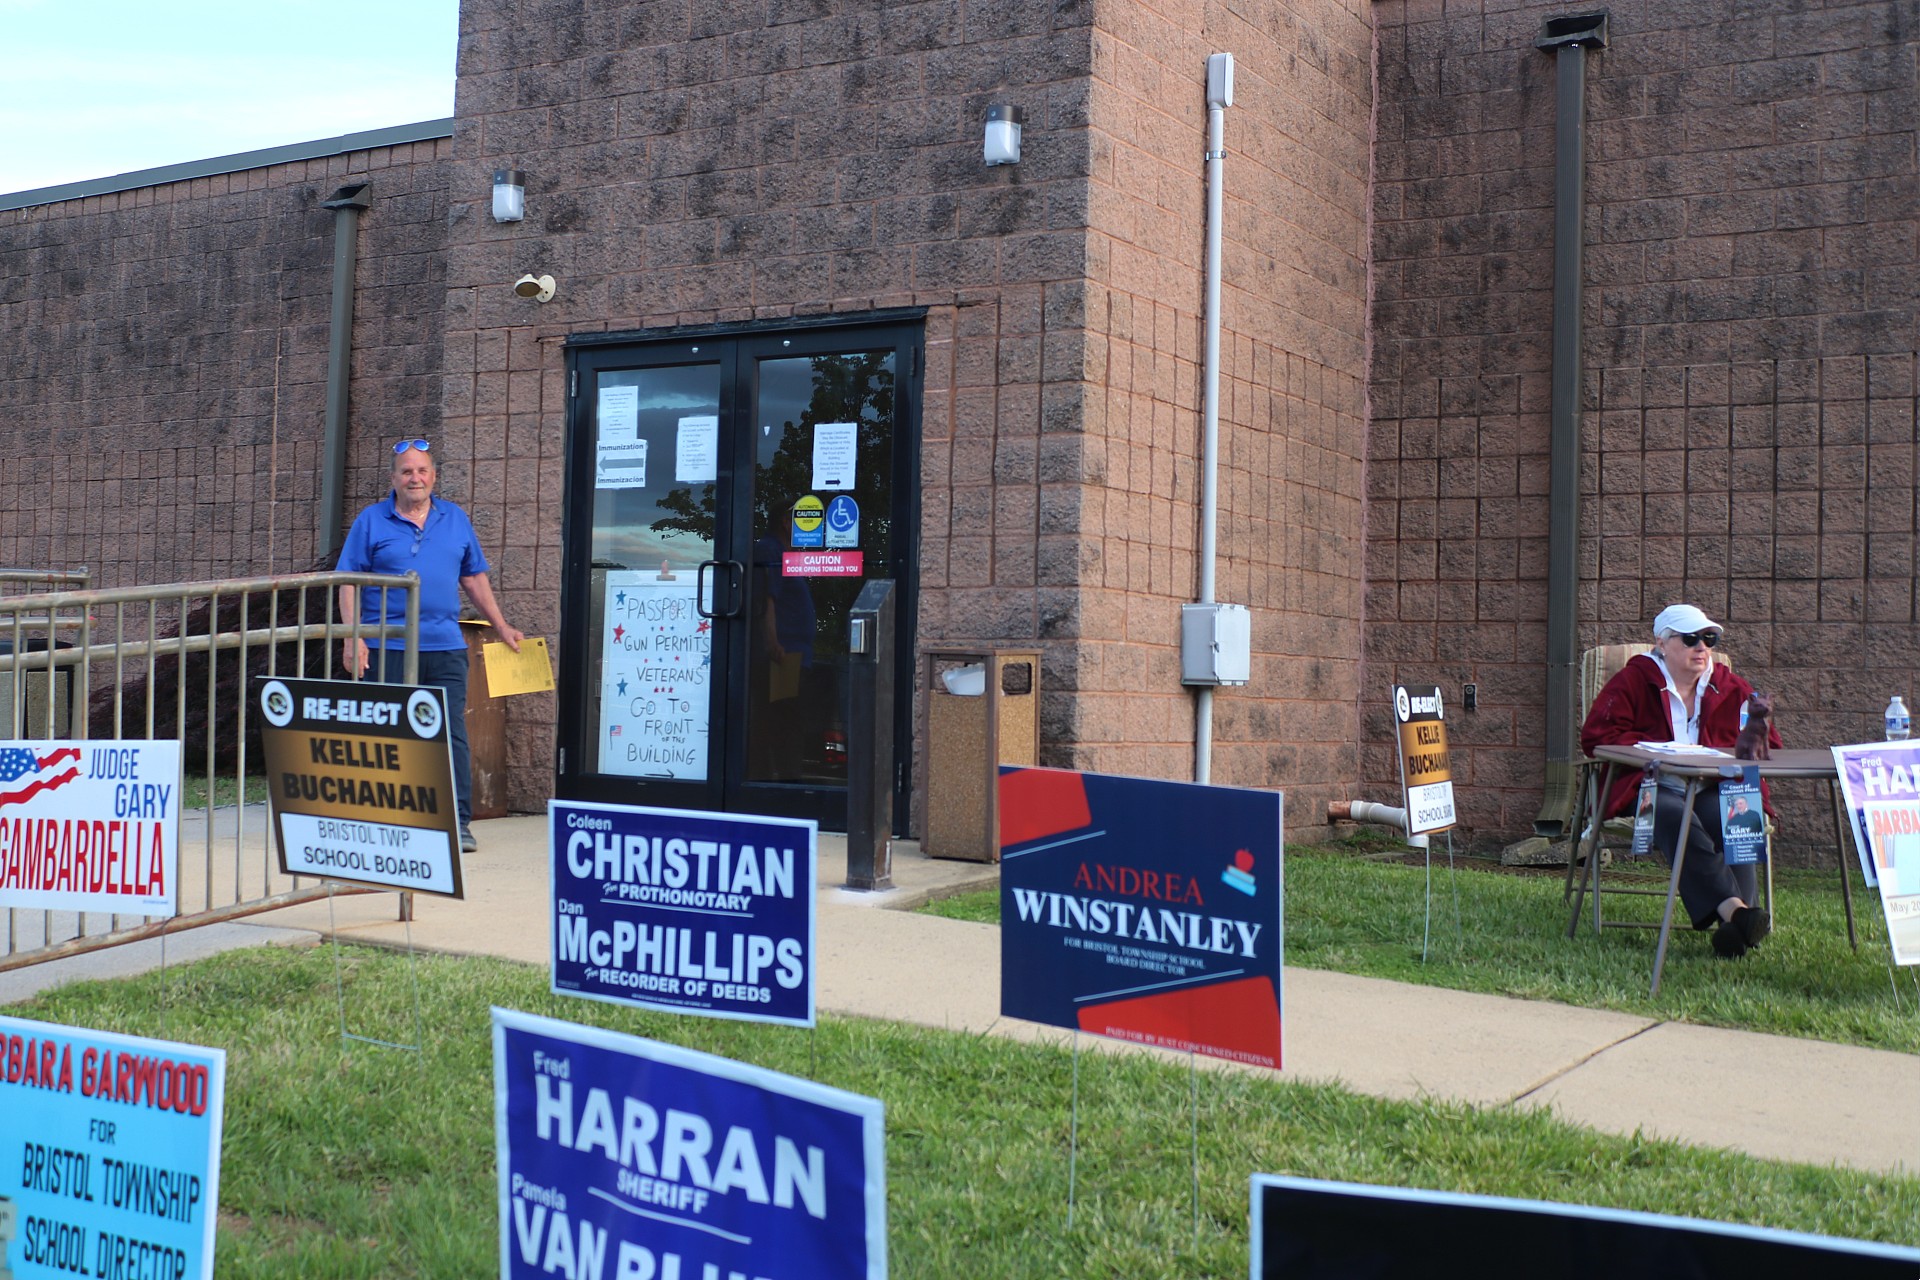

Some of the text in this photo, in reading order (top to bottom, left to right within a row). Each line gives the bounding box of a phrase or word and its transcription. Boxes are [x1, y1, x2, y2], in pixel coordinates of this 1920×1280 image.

[599, 443, 644, 451] Immunization
[804, 556, 841, 565] CAUTION
[624, 635, 648, 652] GUN
[637, 667, 703, 685] VETERANS
[302, 697, 402, 726] RE-ELECT
[644, 718, 694, 736] FRONT
[88, 749, 140, 780] JUDGE
[309, 737, 400, 771] KELLIE
[1861, 756, 1882, 767] Fred
[115, 784, 171, 819] GARY
[282, 772, 439, 815] BUCHANAN
[318, 820, 410, 848] BRISTOL TWP
[566, 812, 612, 831] Coleen
[0, 817, 164, 896] GAMBARDELLA
[304, 846, 432, 880] SCHOOL BOARD
[566, 830, 795, 899] CHRISTIAN
[619, 883, 751, 911] PROTHONOTARY
[1073, 862, 1204, 906] ANDREA
[558, 898, 584, 915] Dan
[1012, 887, 1262, 959] WINSTANLEY
[1890, 902, 1908, 915] May
[558, 914, 804, 989] McPHILLIPS
[1064, 936, 1205, 969] FOR BRISTOL TOWNSHIP SCHOOL
[1106, 954, 1186, 976] BOARD DIRECTOR
[600, 968, 680, 994] RECORDER
[684, 981, 708, 997] OF
[712, 984, 772, 1004] DEEDS
[533, 1050, 570, 1080] Fred
[81, 1047, 208, 1117] GARWOOD
[89, 1118, 116, 1145] FOR
[534, 1073, 827, 1220] HARRAN
[22, 1141, 200, 1224] BRISTOL TOWNSHIP
[512, 1172, 568, 1212] Pamela
[617, 1168, 709, 1214] SHERIFF
[24, 1215, 186, 1280] SCHOOL DIRECTOR
[513, 1196, 608, 1280] VAN
